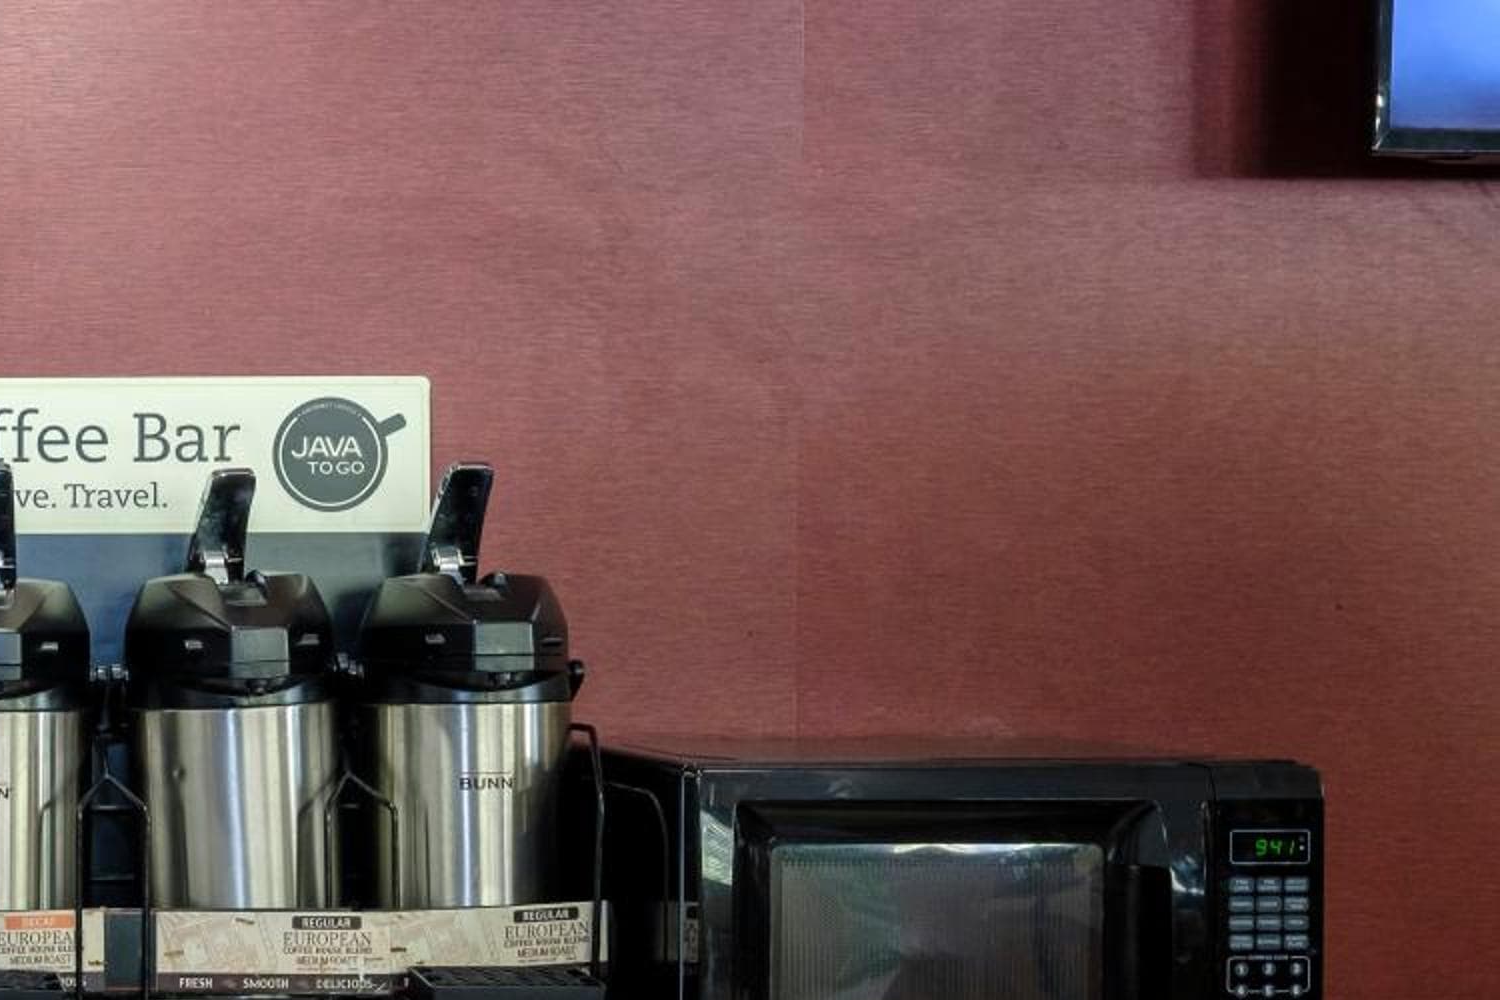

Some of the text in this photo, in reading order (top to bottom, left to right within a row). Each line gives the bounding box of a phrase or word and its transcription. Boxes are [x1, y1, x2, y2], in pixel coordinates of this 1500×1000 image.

[132, 412, 241, 463] Bar
[290, 435, 363, 458] JAVA
[307, 461, 365, 475] TO GO
[15, 487, 57, 510] ve.
[63, 482, 169, 509] Travel.
[459, 776, 513, 791] BUNN
[301, 916, 351, 928] REGULAR
[521, 909, 569, 922] REGULAR
[503, 921, 590, 940] EUROPEAN
[282, 931, 373, 946] EUROPEAN
[179, 977, 374, 989] FRESH SMOOTH DELICIOUS
